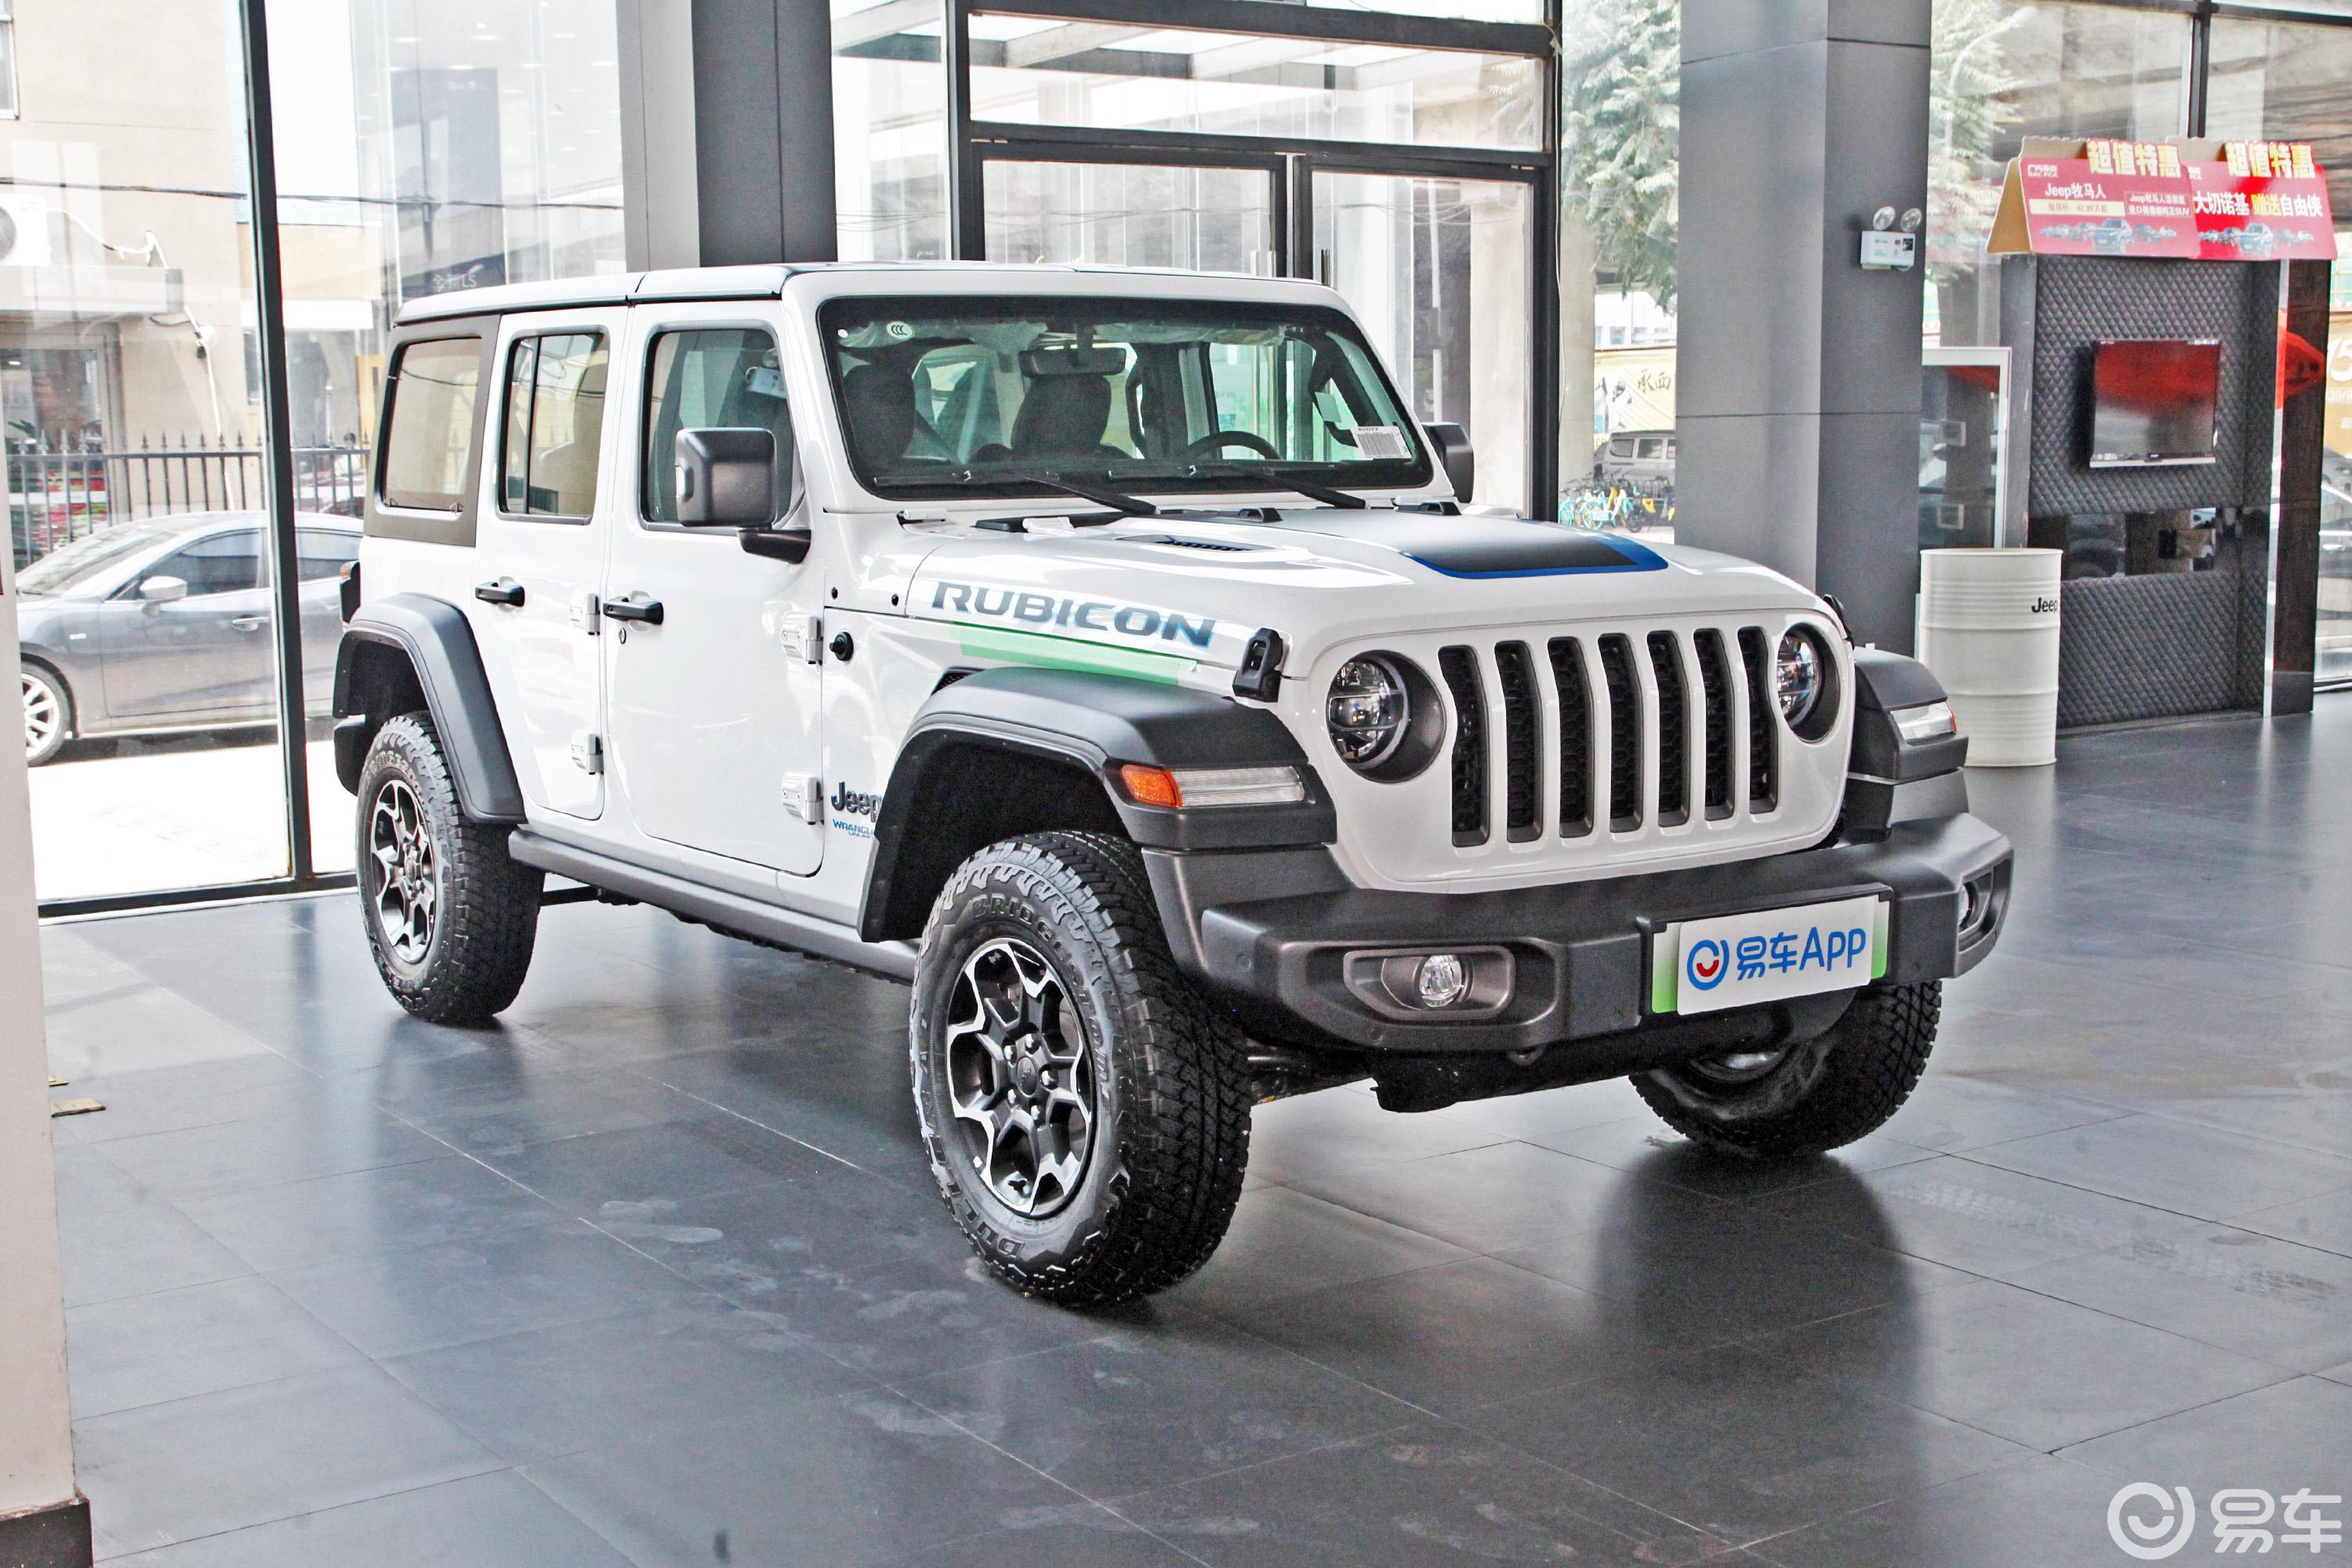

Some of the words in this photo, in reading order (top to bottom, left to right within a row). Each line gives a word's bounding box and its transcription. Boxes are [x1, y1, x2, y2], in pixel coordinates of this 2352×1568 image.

[2088, 142, 2181, 177] 超值特惠
[2225, 143, 2316, 179] 超值特惠
[931, 581, 1217, 648] RUBICON
[2031, 597, 2058, 614] Jeep
[831, 781, 882, 822] Jeep
[833, 819, 875, 835] WRANGL
[1737, 926, 1867, 981] 易车App
